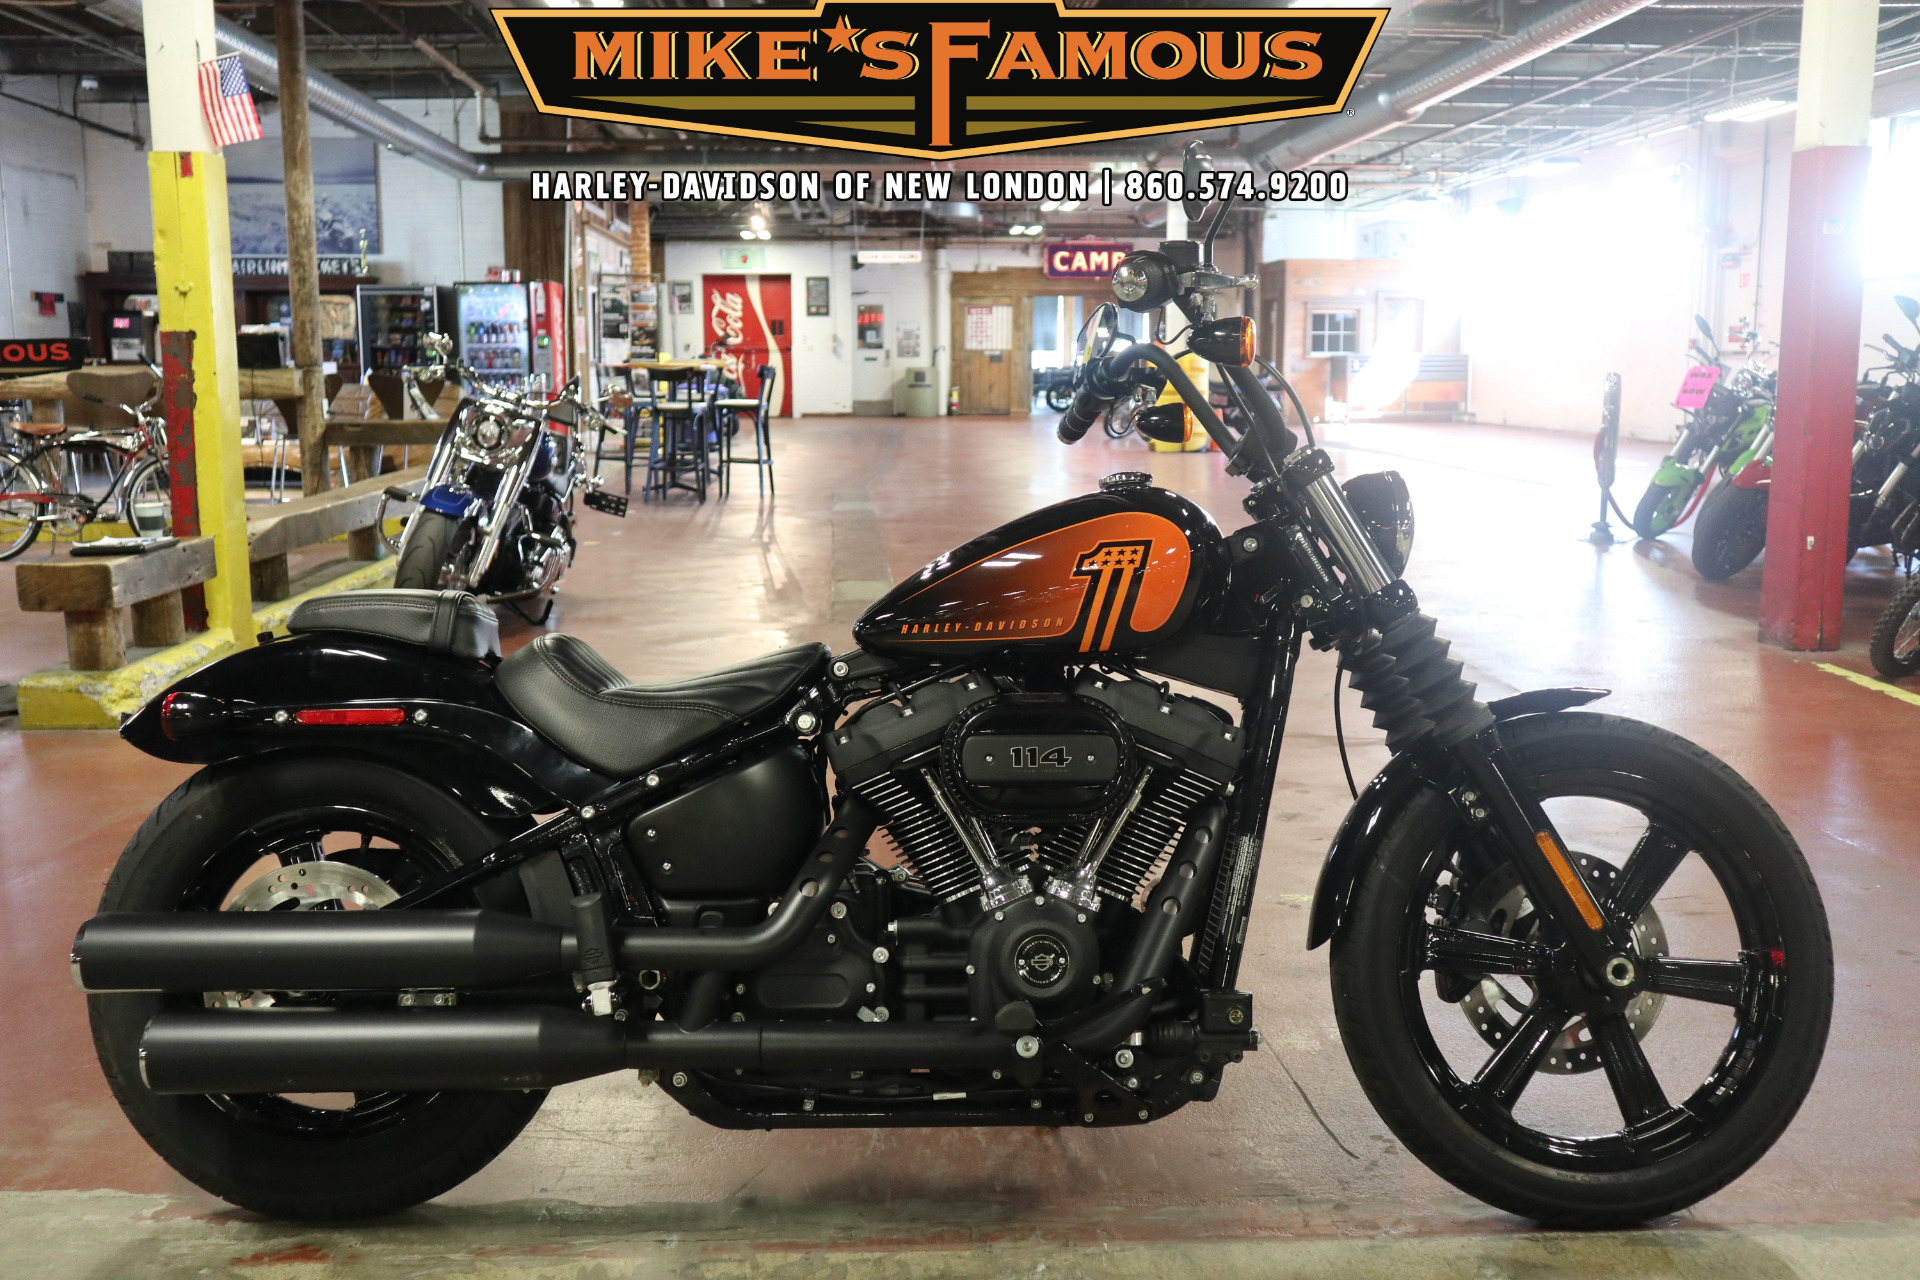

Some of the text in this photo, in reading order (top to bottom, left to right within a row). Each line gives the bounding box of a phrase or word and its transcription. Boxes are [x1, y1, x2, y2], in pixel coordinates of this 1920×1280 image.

[0, 342, 70, 362] OUS
[901, 618, 1065, 634] HARLEY-DAVIDSON
[1010, 745, 1073, 768] 114
